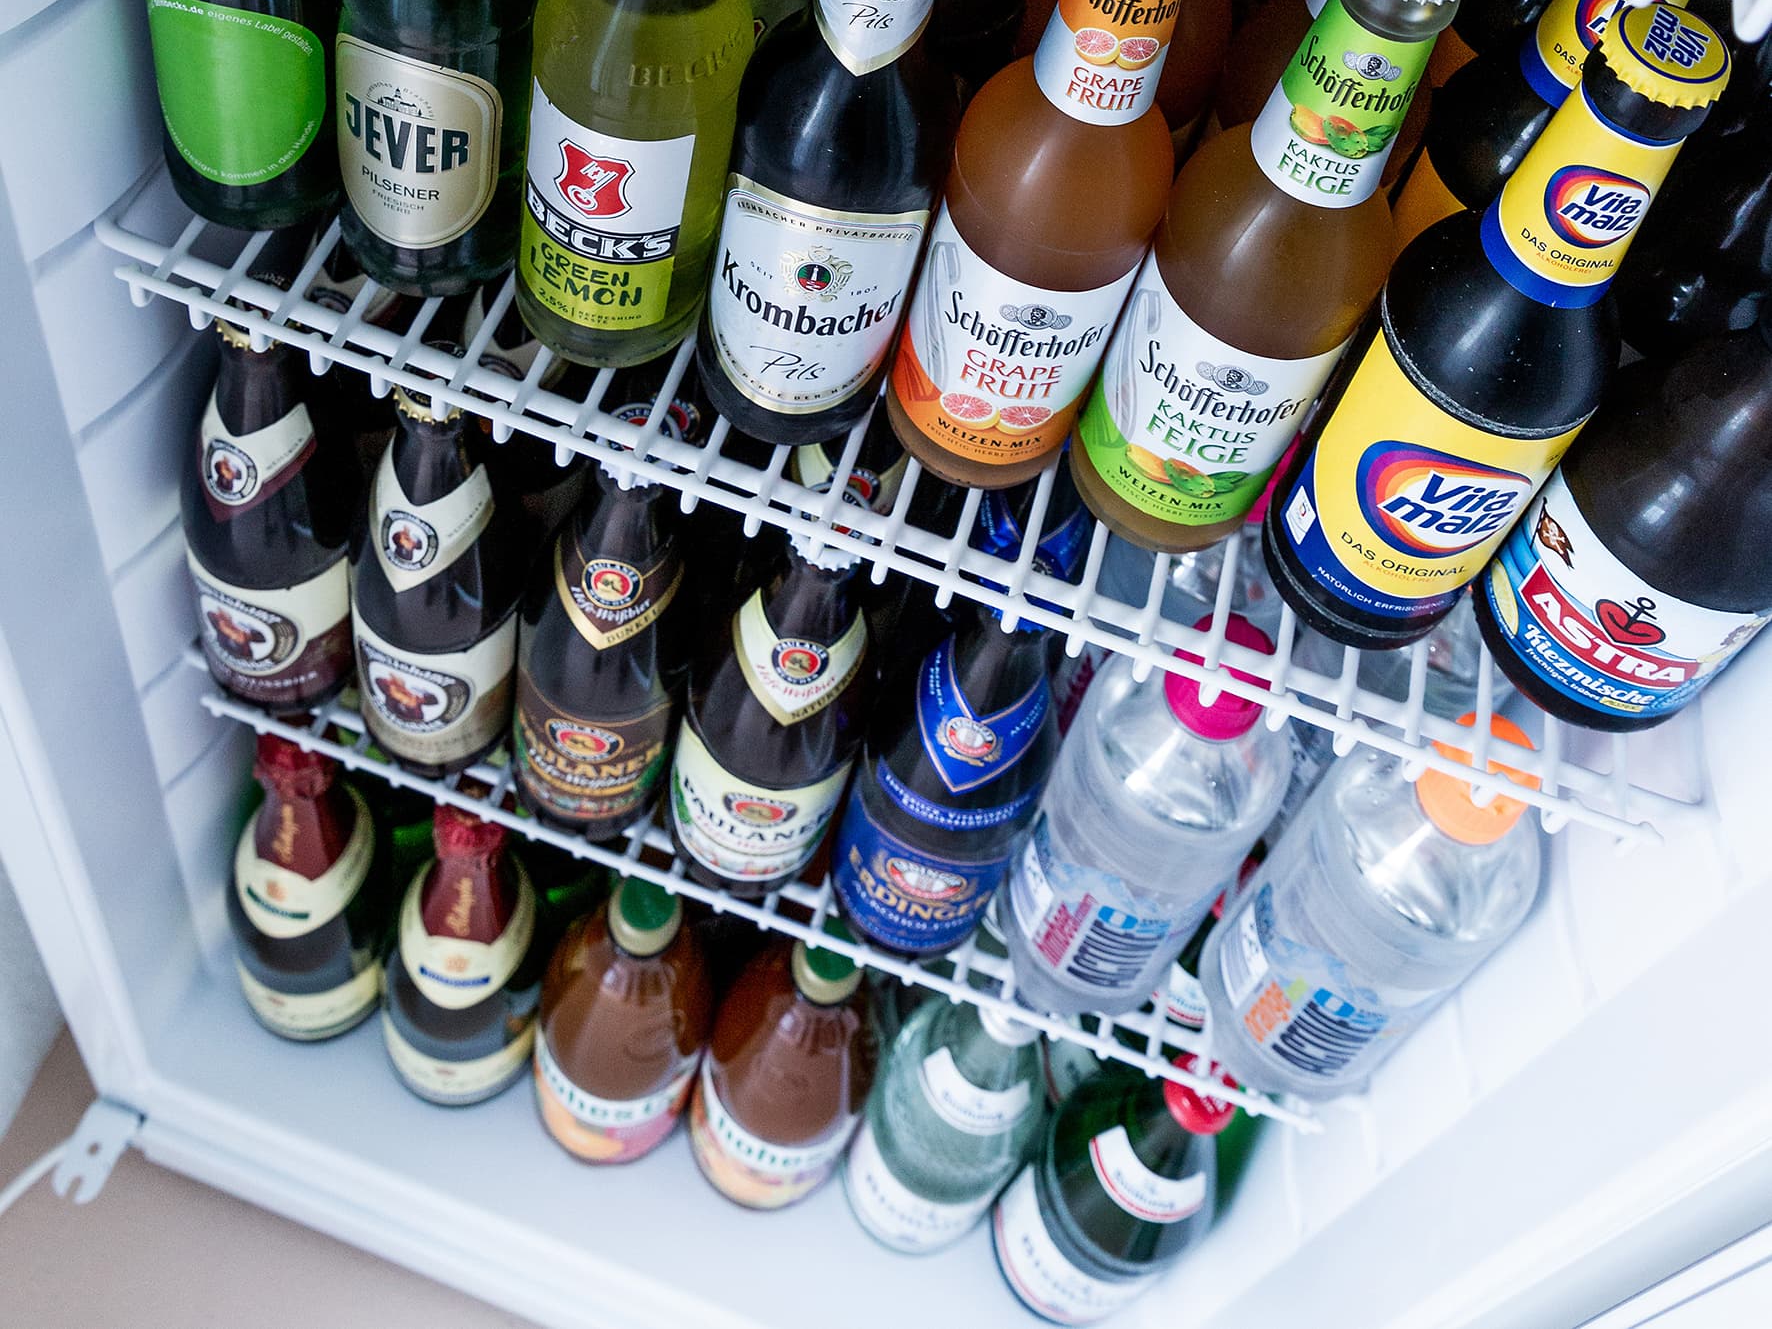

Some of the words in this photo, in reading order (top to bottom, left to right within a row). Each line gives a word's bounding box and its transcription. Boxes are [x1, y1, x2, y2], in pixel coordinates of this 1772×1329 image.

[207, 8, 253, 27] eigenes
[254, 19, 283, 36] Label
[842, 2, 894, 30] Pils
[1643, 6, 1680, 63] malz
[1554, 42, 1577, 67] DAS
[1670, 25, 1710, 69] Vita
[1064, 79, 1143, 110] FRUIT
[1072, 65, 1145, 92] GRAPE
[345, 91, 471, 174] JEVER
[220, 167, 268, 180] kommen
[267, 162, 278, 172] in
[278, 150, 296, 165] den
[1276, 153, 1354, 197] FEIGE
[1285, 138, 1361, 176] KAKTUS
[361, 164, 441, 202] PILSENER
[372, 188, 425, 211] FRIESISCH
[1583, 183, 1640, 218] Vita
[526, 183, 672, 260] BECK'S
[737, 200, 807, 229] KROMBACHER
[814, 224, 914, 243] PRIVATBRAUEREI
[1559, 198, 1635, 233] malz
[540, 240, 631, 288] GREEN
[1520, 227, 1546, 254] DAS
[1548, 246, 1615, 269] ORIGINAL
[529, 245, 643, 307] LEMON
[721, 247, 902, 338] Krombacher
[749, 260, 775, 281] SEIT
[849, 286, 878, 297] 1803
[944, 290, 1109, 360] Schöfferhofer
[749, 345, 830, 382] Pils
[959, 363, 1062, 399] FRUIT
[966, 348, 1063, 381] GRAPE
[793, 392, 822, 402] DER
[1138, 340, 1307, 428] Schöfferhofer
[936, 416, 1043, 449] WEIZEN-MIX
[1145, 412, 1248, 465] FEIGE
[1157, 398, 1257, 445] KAKTUS
[1118, 465, 1225, 511] WEIZEN-MIX
[1419, 472, 1519, 512] Vita
[1382, 495, 1511, 534] malz
[588, 562, 639, 583] PAULANER
[1340, 530, 1377, 562] DAS
[1380, 558, 1468, 578] ORIGINAL
[1316, 565, 1373, 605] NATÜRLICH
[606, 608, 661, 645] DUNKEL
[1530, 590, 1687, 684] ASTRA
[775, 640, 828, 660] PAULANER
[1524, 624, 1656, 707] Kiezmische
[682, 773, 830, 843] PAULANER
